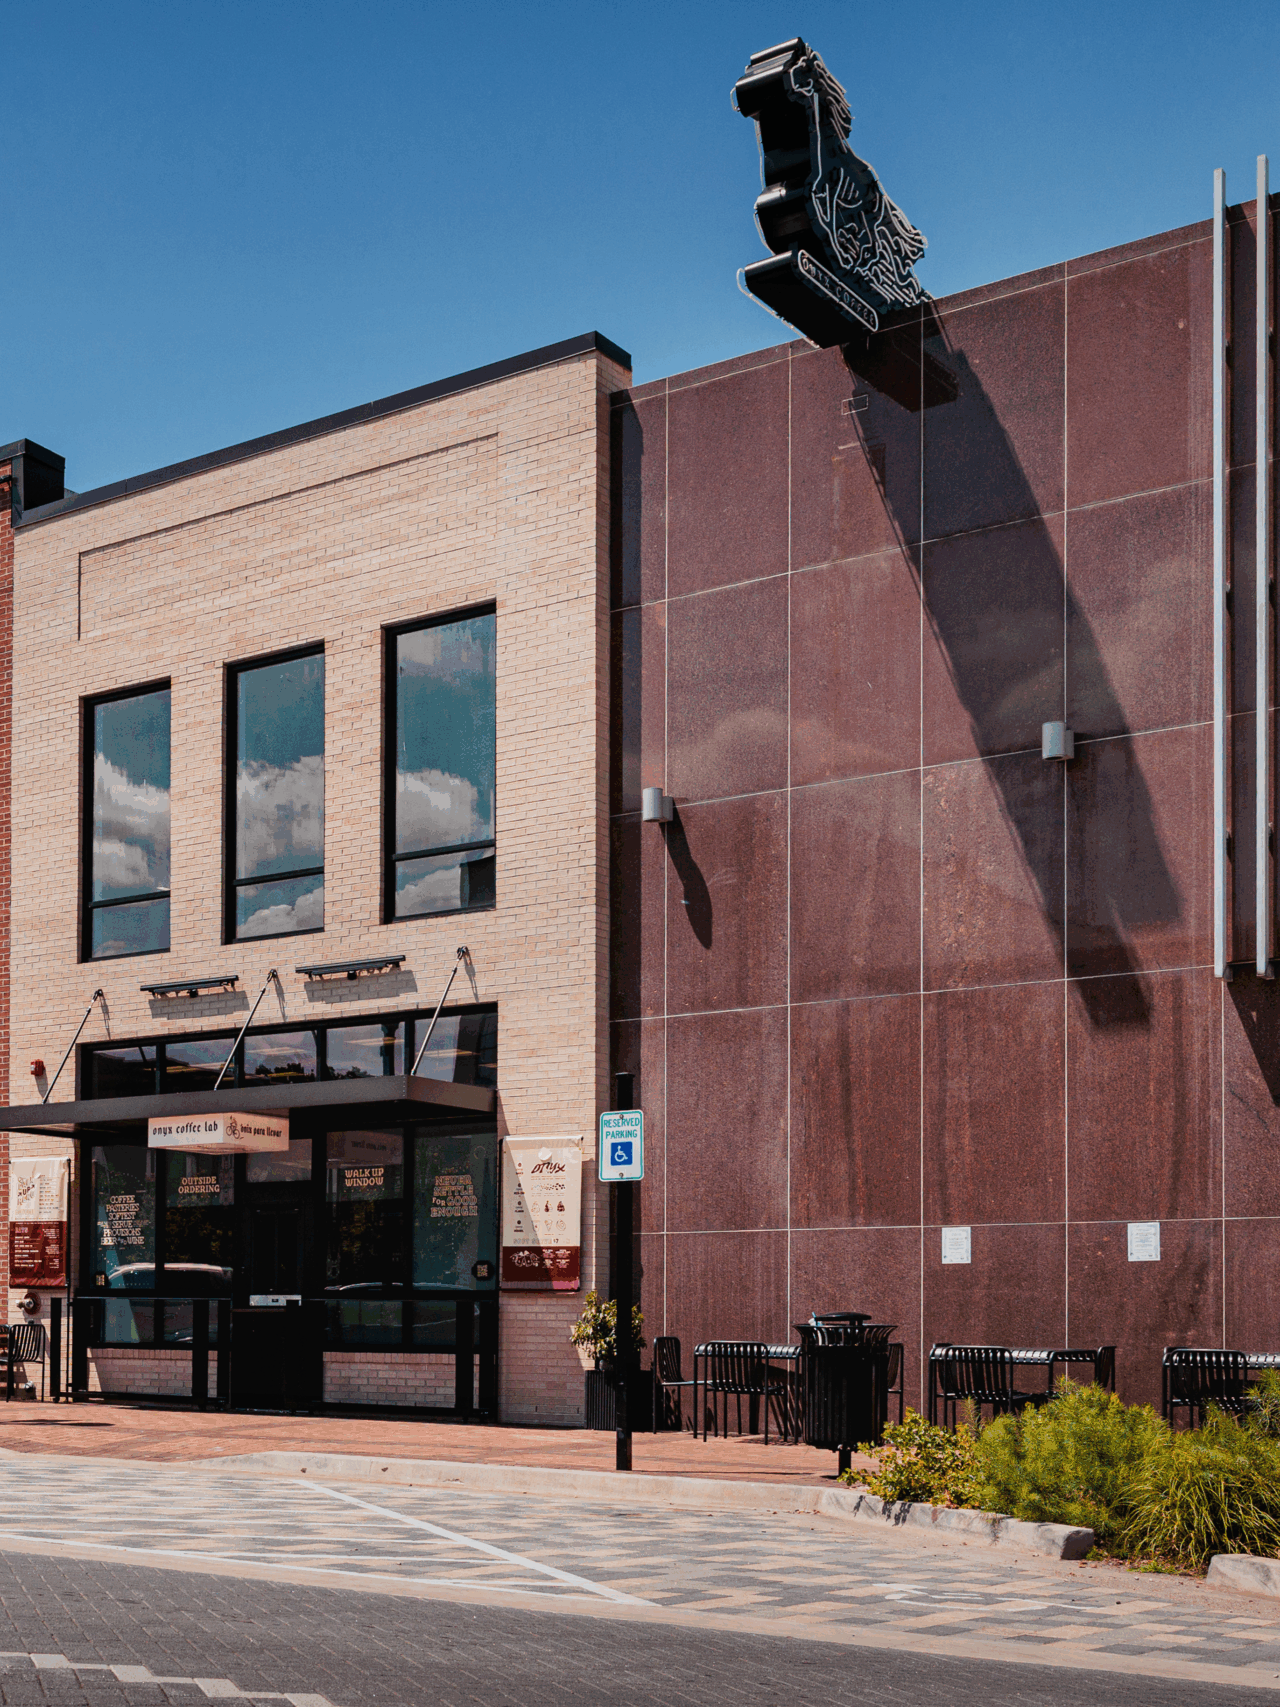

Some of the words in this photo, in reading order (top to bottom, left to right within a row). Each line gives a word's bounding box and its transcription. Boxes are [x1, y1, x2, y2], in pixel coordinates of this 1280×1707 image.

[603, 1117, 640, 1128] RESERVED
[152, 1124, 173, 1137] onyx
[175, 1121, 202, 1134] coffee
[204, 1120, 219, 1132] lab
[605, 1129, 638, 1139] PARKING
[344, 1168, 370, 1178] WALK
[371, 1167, 384, 1177] UP
[181, 1175, 217, 1186] OUTSIDE
[344, 1176, 384, 1187] WINDOW
[435, 1174, 472, 1186] NEVER
[178, 1184, 220, 1194] ORDERING
[110, 1194, 136, 1204] COFFEE
[446, 1195, 478, 1206] GOOD
[430, 1205, 478, 1218] ENOUGH
[100, 1236, 118, 1246] BEER
[127, 1236, 145, 1245] WINE
